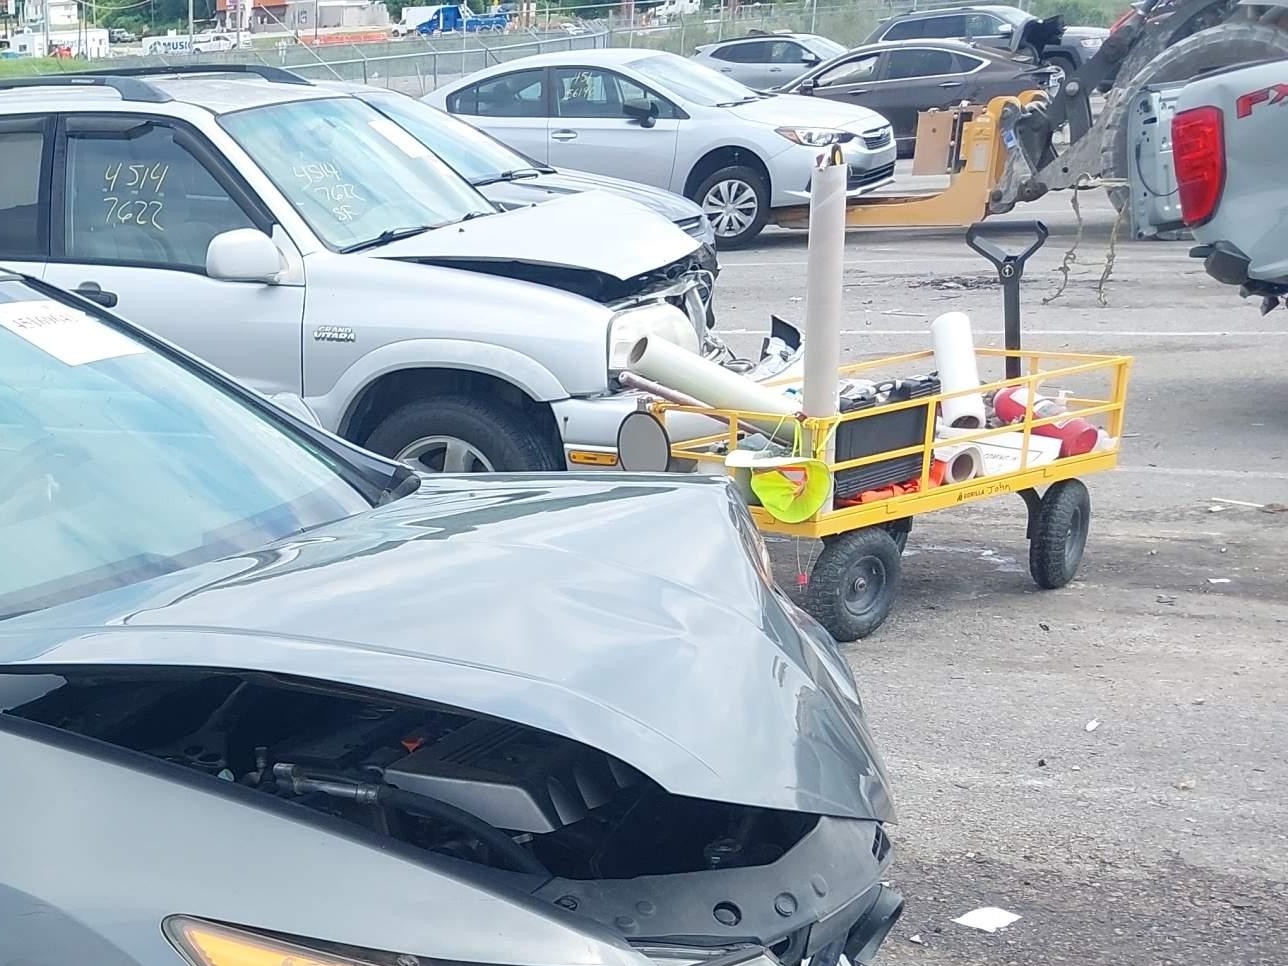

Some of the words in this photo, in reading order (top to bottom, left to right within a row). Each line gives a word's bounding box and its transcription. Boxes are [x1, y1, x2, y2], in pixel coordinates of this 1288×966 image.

[105, 162, 169, 193] 4514
[104, 196, 165, 231] 7622
[313, 331, 356, 341] VITARA
